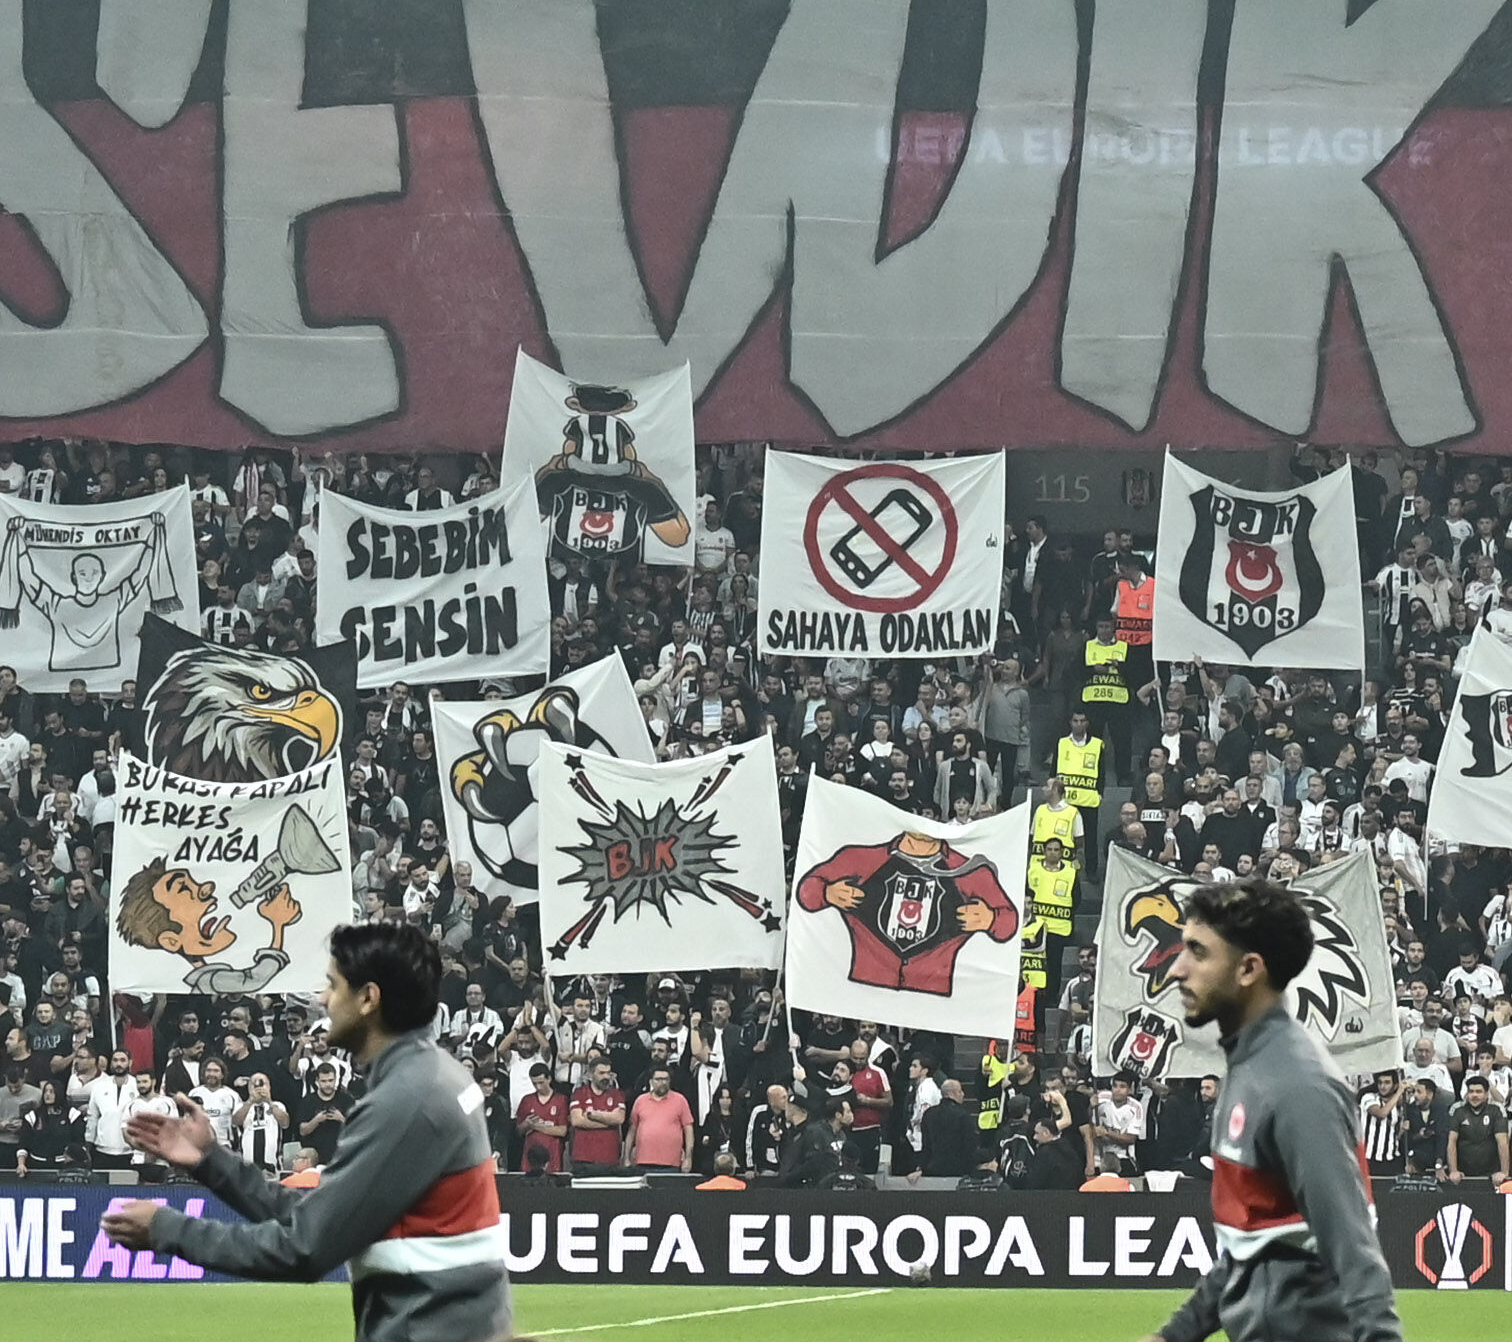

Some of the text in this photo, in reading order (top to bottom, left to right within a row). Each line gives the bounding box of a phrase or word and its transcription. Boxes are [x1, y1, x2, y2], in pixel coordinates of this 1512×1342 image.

[575, 490, 627, 511] BJK
[1211, 492, 1298, 541] BJK
[95, 523, 141, 545] OKTAY
[346, 506, 515, 582] SEBEBİM
[338, 582, 519, 662] SENSİN
[767, 608, 993, 653] SAHAYA ODAKLAN
[1212, 600, 1299, 631] 1903
[120, 796, 234, 830] HERKES
[173, 826, 259, 864] AYAĞA
[895, 877, 935, 900] BJK
[502, 1213, 1219, 1277] UEFA EUROPA LEA
